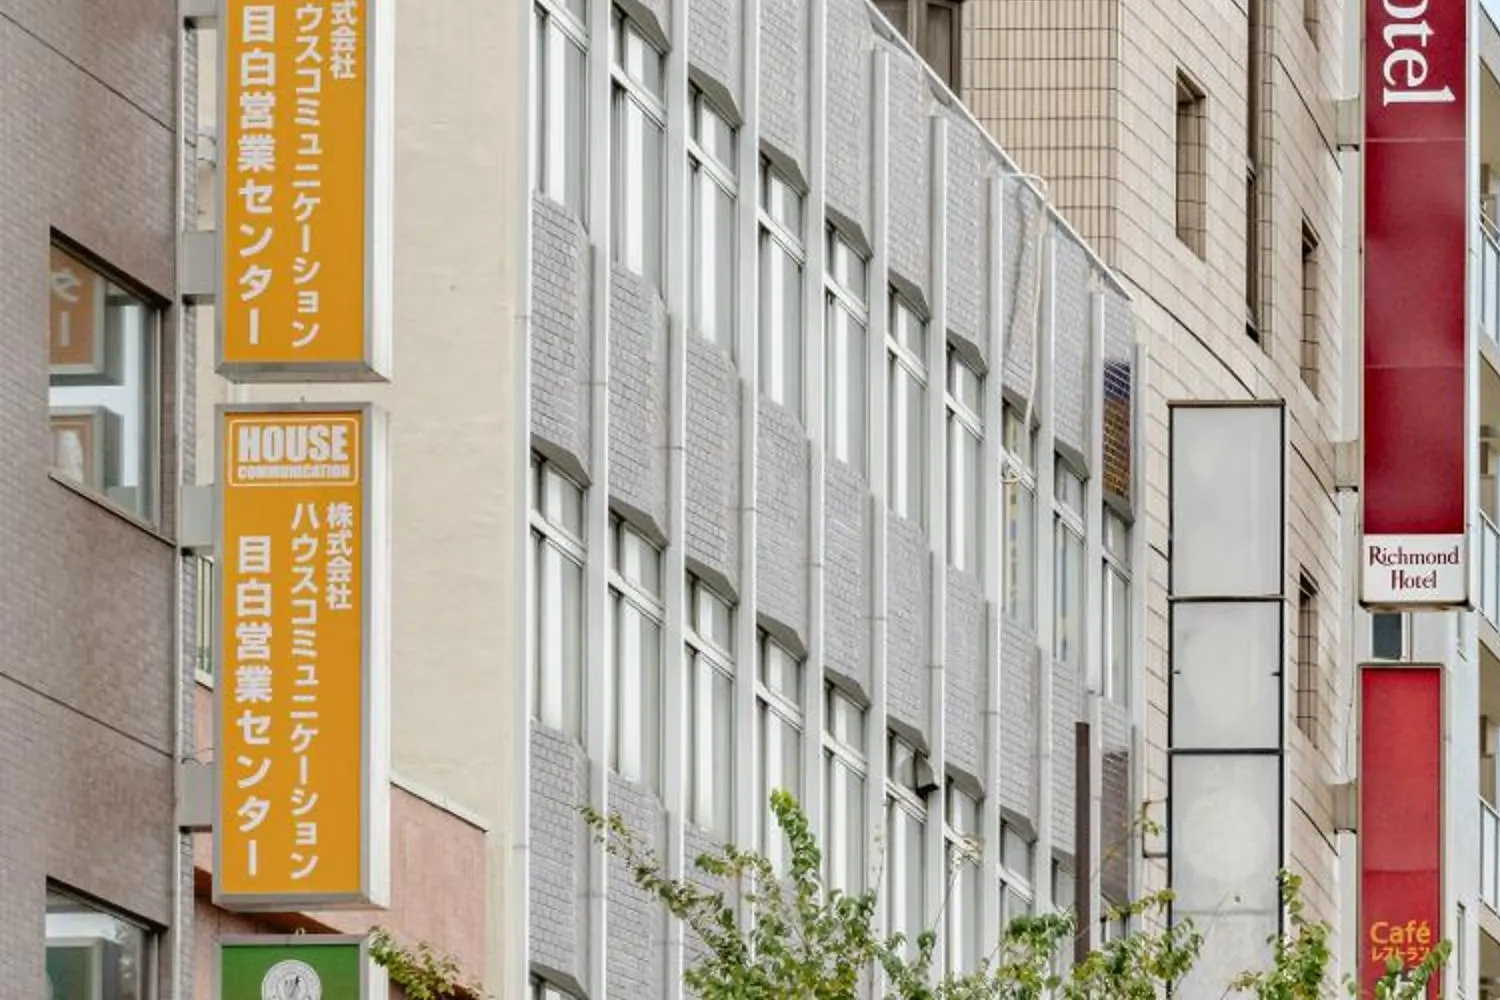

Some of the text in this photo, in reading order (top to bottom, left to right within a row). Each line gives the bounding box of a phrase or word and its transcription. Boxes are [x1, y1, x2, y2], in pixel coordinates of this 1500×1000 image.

[236, 4, 278, 346] 目白営業センター
[237, 424, 349, 462] HOUSE
[326, 501, 354, 611] 株式会社
[1368, 545, 1460, 567] Richmond
[1391, 569, 1437, 591] Hotel
[234, 534, 274, 878] 目白営業センター
[289, 502, 321, 881] ハウスコミュニケーション
[1370, 919, 1431, 945] Café
